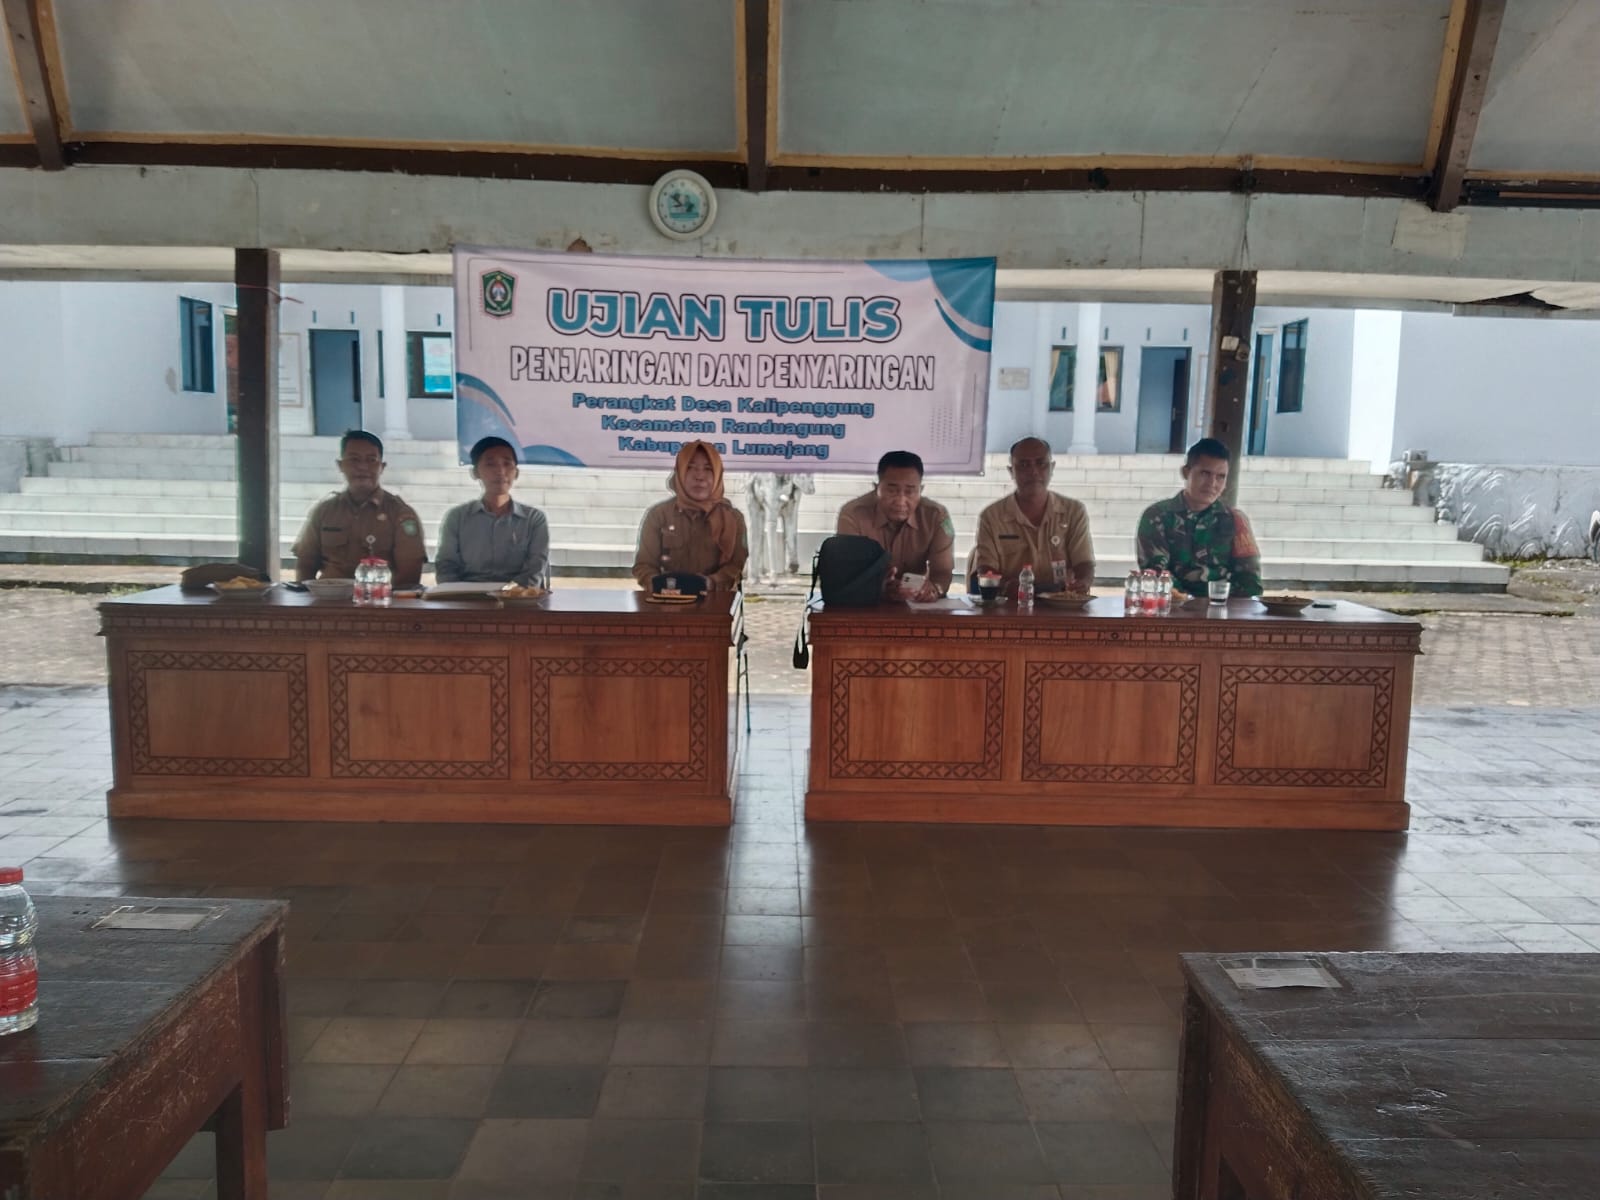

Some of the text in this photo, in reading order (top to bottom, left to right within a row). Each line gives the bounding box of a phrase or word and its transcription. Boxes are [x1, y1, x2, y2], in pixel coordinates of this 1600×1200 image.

[548, 288, 901, 342] UJIAN TULIS
[510, 346, 935, 391] PENJARINGAN DAN PENYARINGAN
[572, 392, 874, 418] Perangkat Desa Kalipenggung
[601, 414, 845, 438] Kecamatan Randuagung
[618, 435, 829, 459] Kabupn Lumajang
